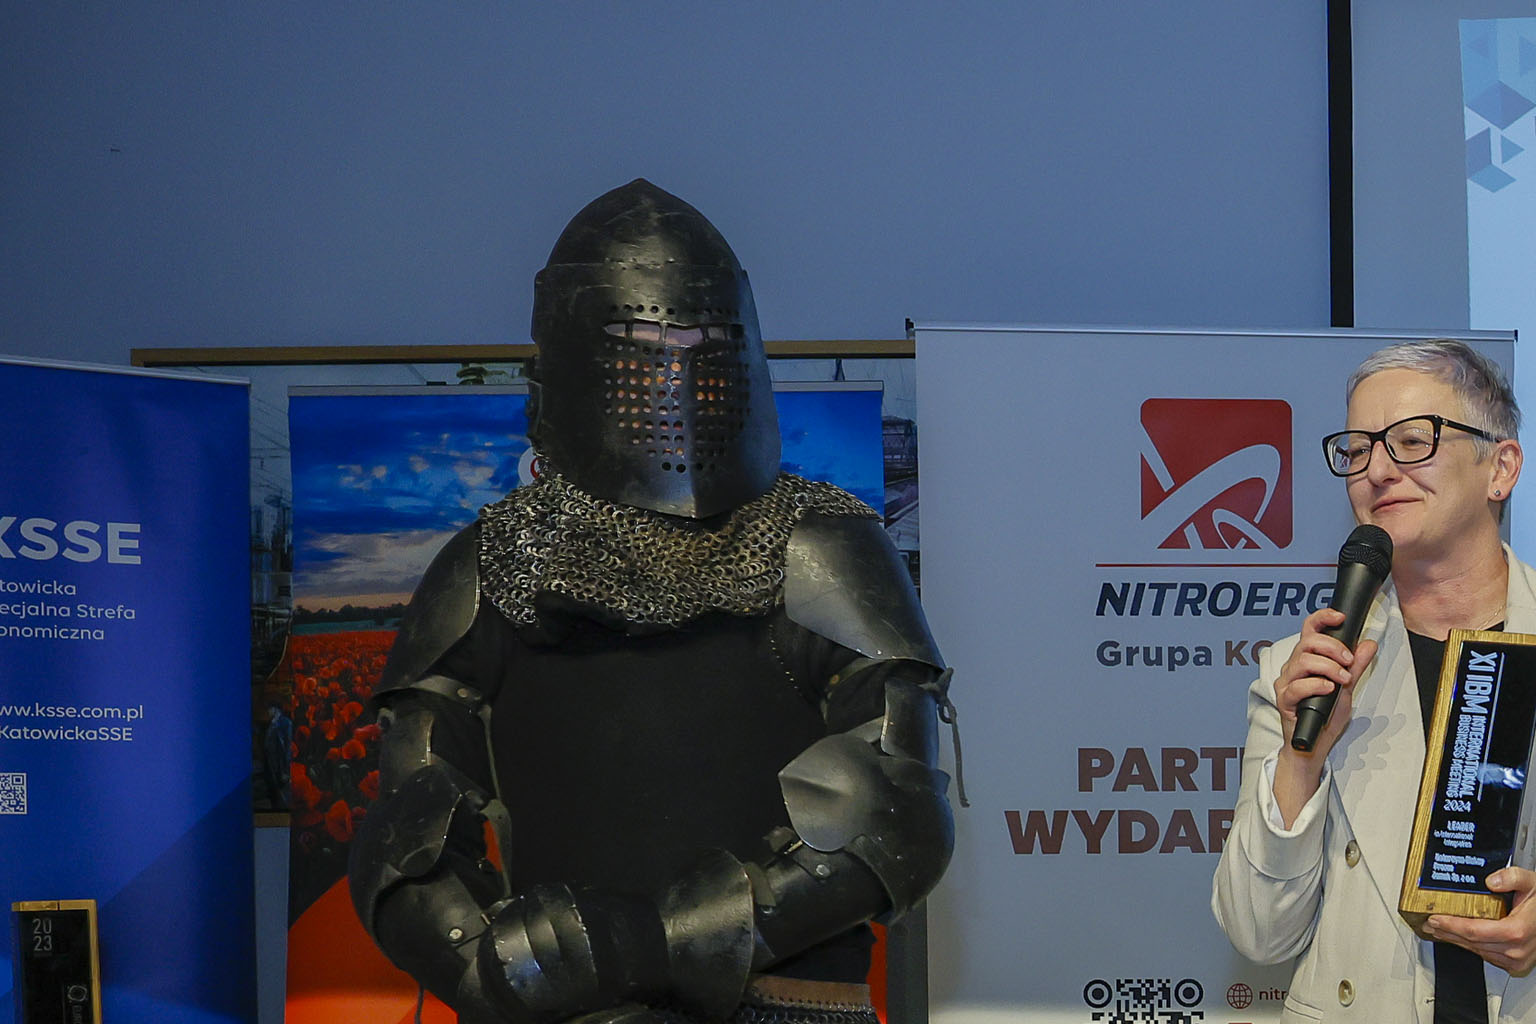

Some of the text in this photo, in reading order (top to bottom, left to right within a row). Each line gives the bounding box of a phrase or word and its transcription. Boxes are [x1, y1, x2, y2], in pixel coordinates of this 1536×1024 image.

[77, 604, 136, 620] Strefa
[1096, 640, 1212, 672] Grupa
[1461, 650, 1498, 714] XI IBM
[1077, 747, 1246, 792] PART
[1446, 714, 1472, 798] BUSINESS MEETING
[1459, 715, 1487, 799] INTERNATIONAL
[1443, 799, 1473, 813] 2024
[33, 935, 53, 951] 23
